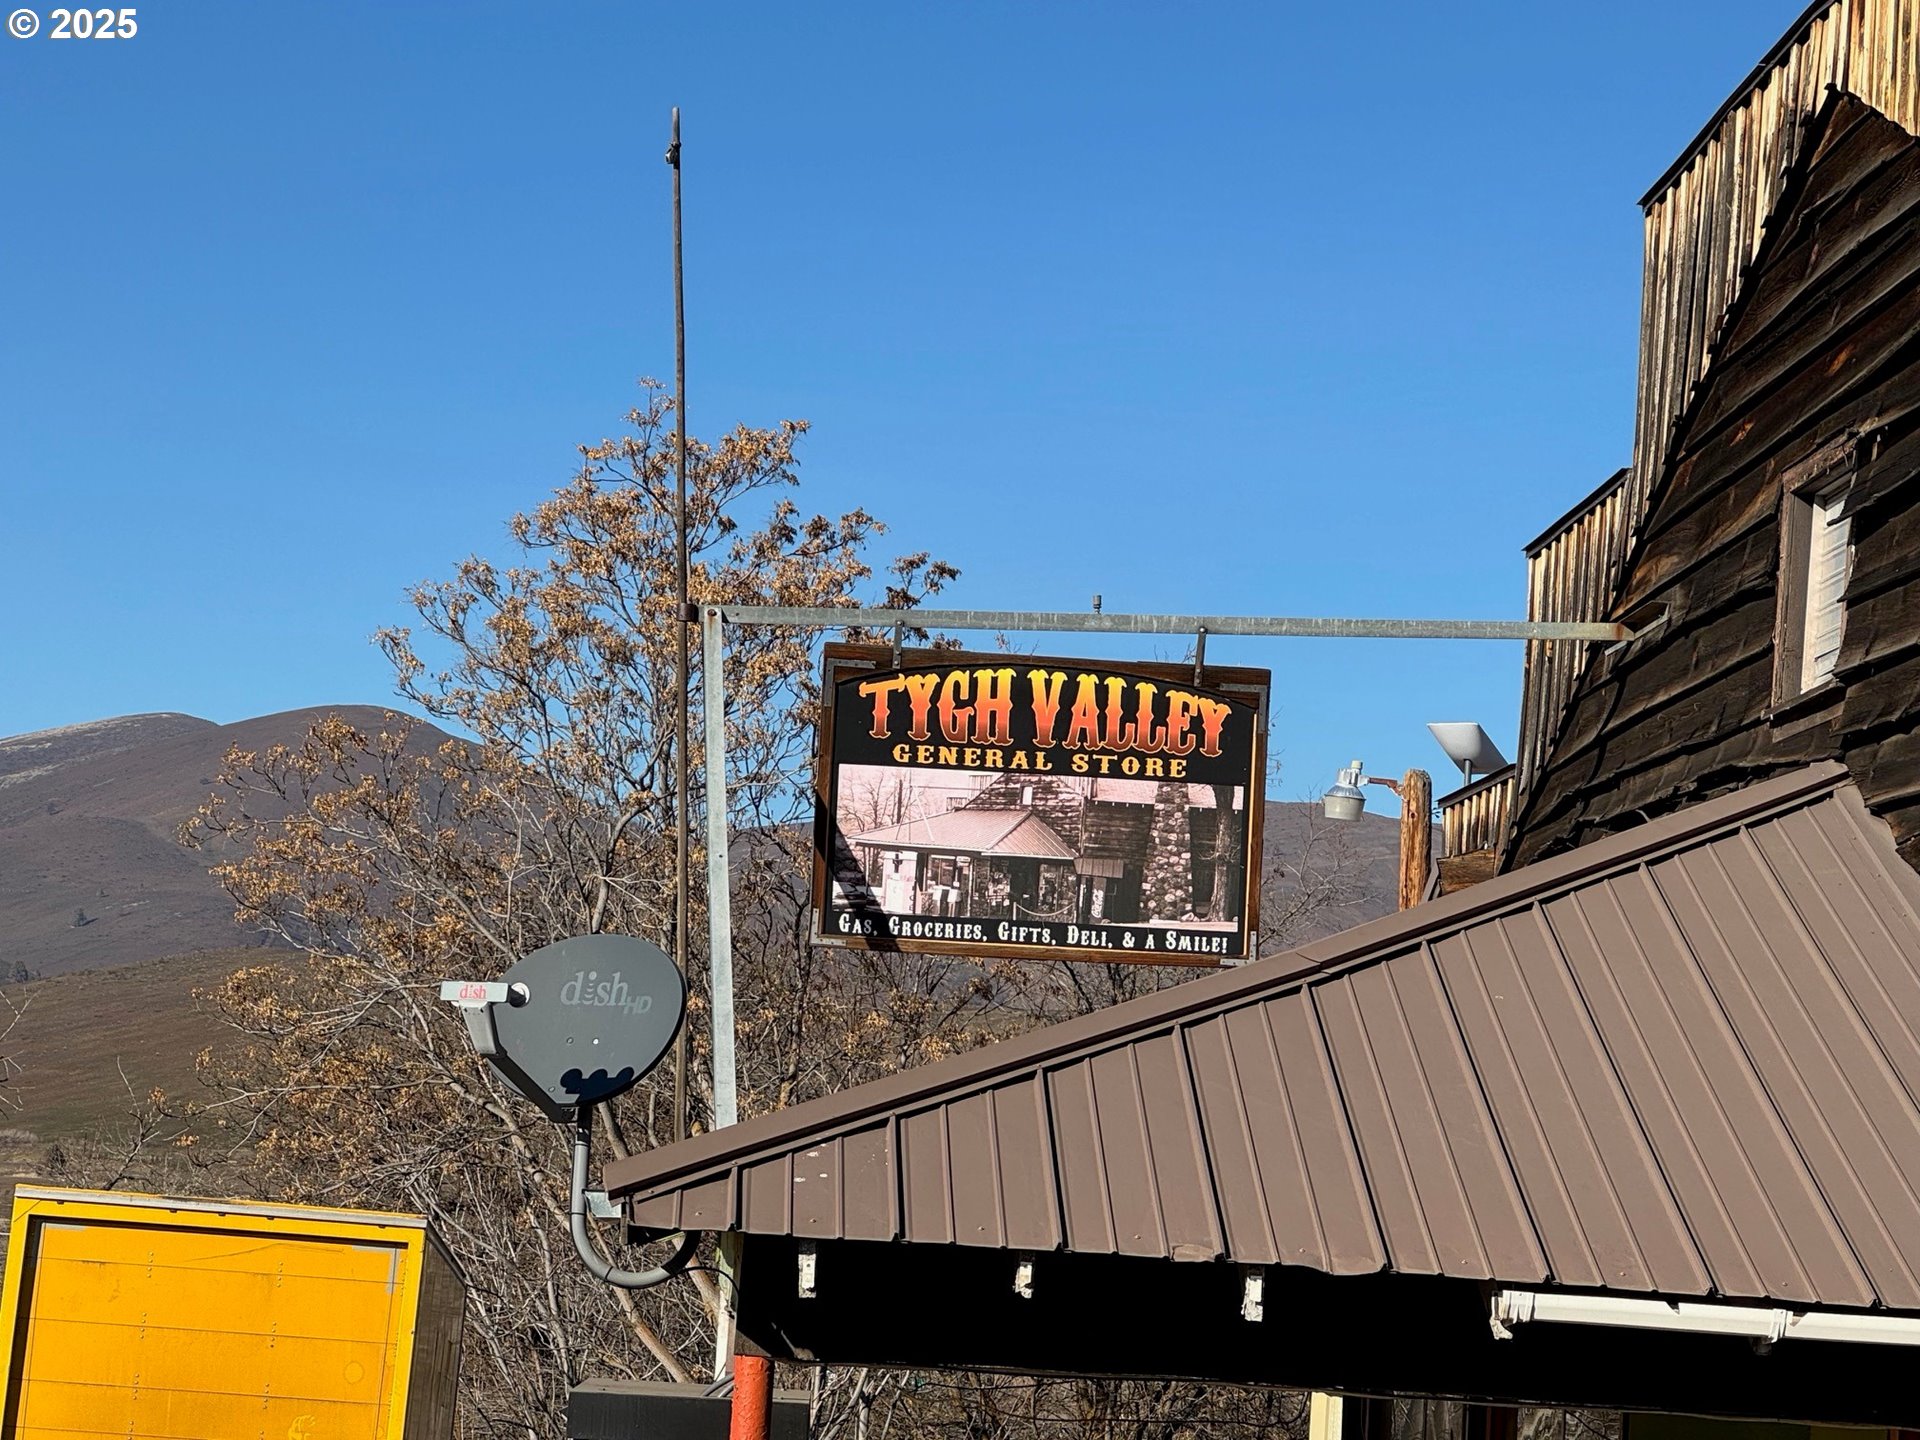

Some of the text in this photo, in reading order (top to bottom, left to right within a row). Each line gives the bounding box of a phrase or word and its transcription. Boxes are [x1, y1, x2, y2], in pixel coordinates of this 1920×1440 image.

[859, 668, 1232, 758] TYGH VALLEY
[892, 743, 1188, 778] GENERAL STORE
[838, 913, 878, 936] GAS,
[888, 915, 988, 942] GROCERIES,
[997, 921, 1057, 946] GIFTS,
[1066, 925, 1113, 949] DELI,
[1122, 931, 1136, 948] &
[1165, 930, 1229, 954] SMILE!
[460, 984, 487, 1000] dish
[560, 971, 629, 1006] dish
